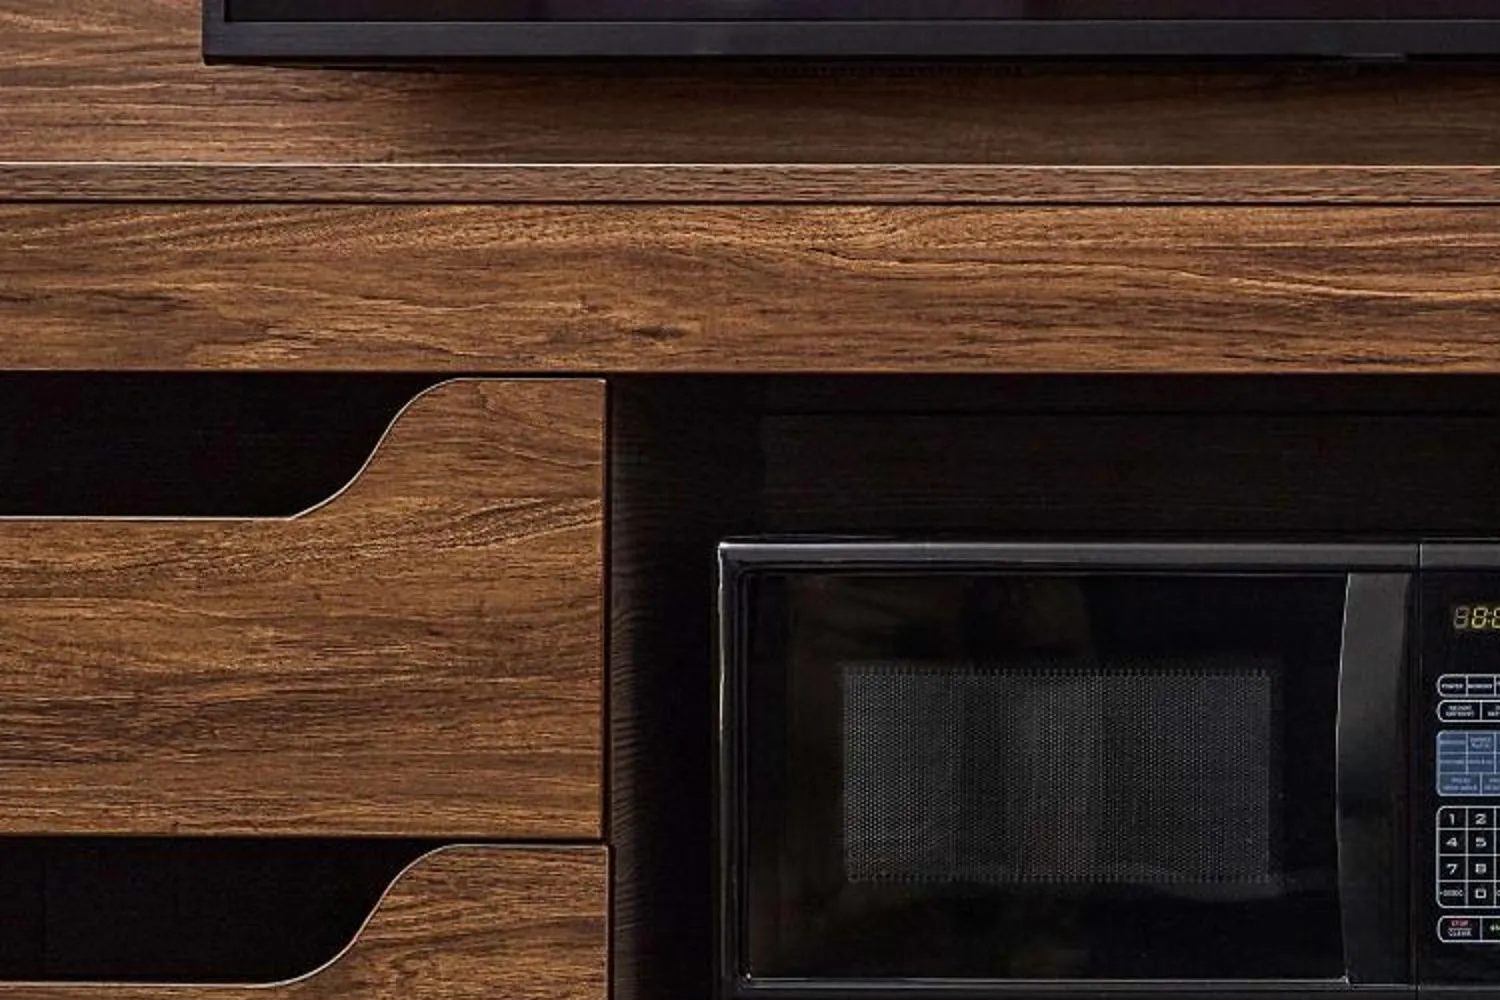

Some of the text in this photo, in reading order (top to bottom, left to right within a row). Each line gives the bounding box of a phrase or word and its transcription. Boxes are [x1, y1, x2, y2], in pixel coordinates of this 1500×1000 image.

[1449, 813, 1455, 825] 1
[1475, 813, 1486, 825] 2
[1446, 837, 1458, 847] 4
[1475, 837, 1487, 848] 5
[1446, 863, 1457, 875] 7
[1475, 863, 1487, 874] 8
